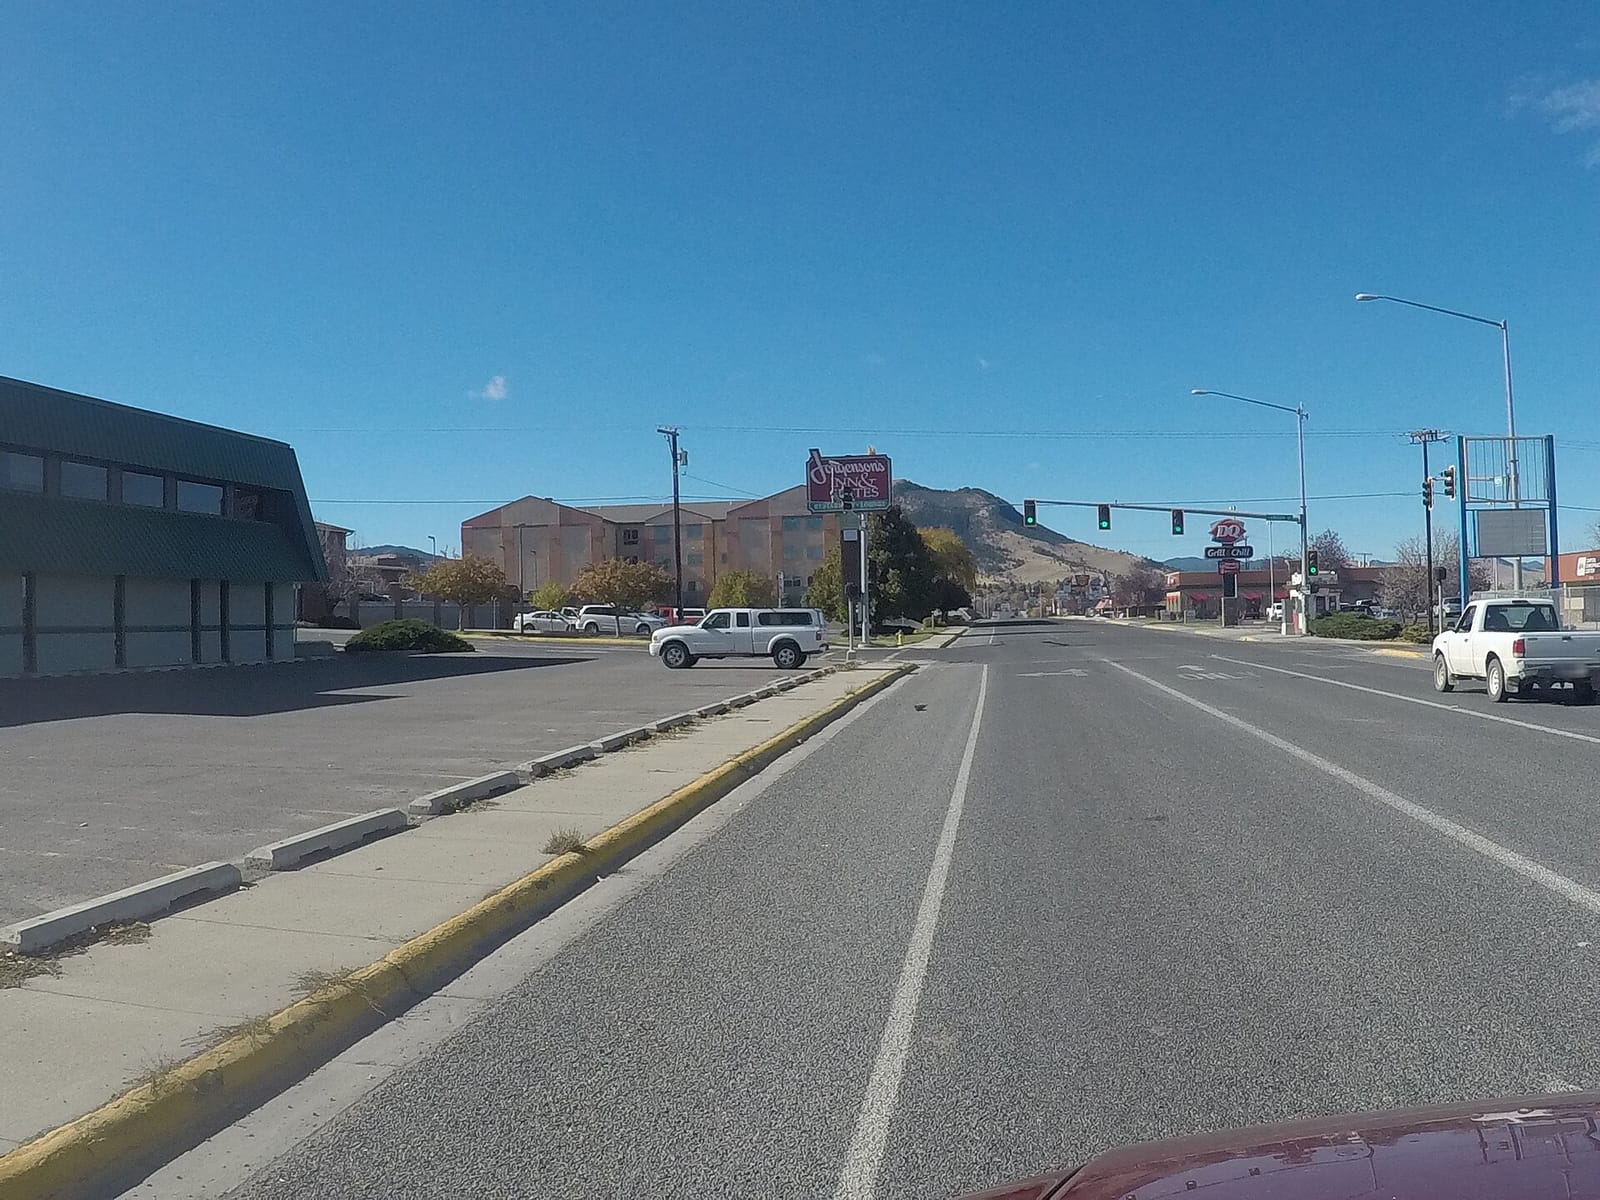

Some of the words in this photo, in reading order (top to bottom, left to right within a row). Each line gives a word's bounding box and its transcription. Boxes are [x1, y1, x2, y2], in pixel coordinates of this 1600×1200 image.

[859, 472, 879, 488] &
[1216, 525, 1241, 537] DQ
[1207, 548, 1226, 557] Grill
[1231, 547, 1250, 557] Chill
